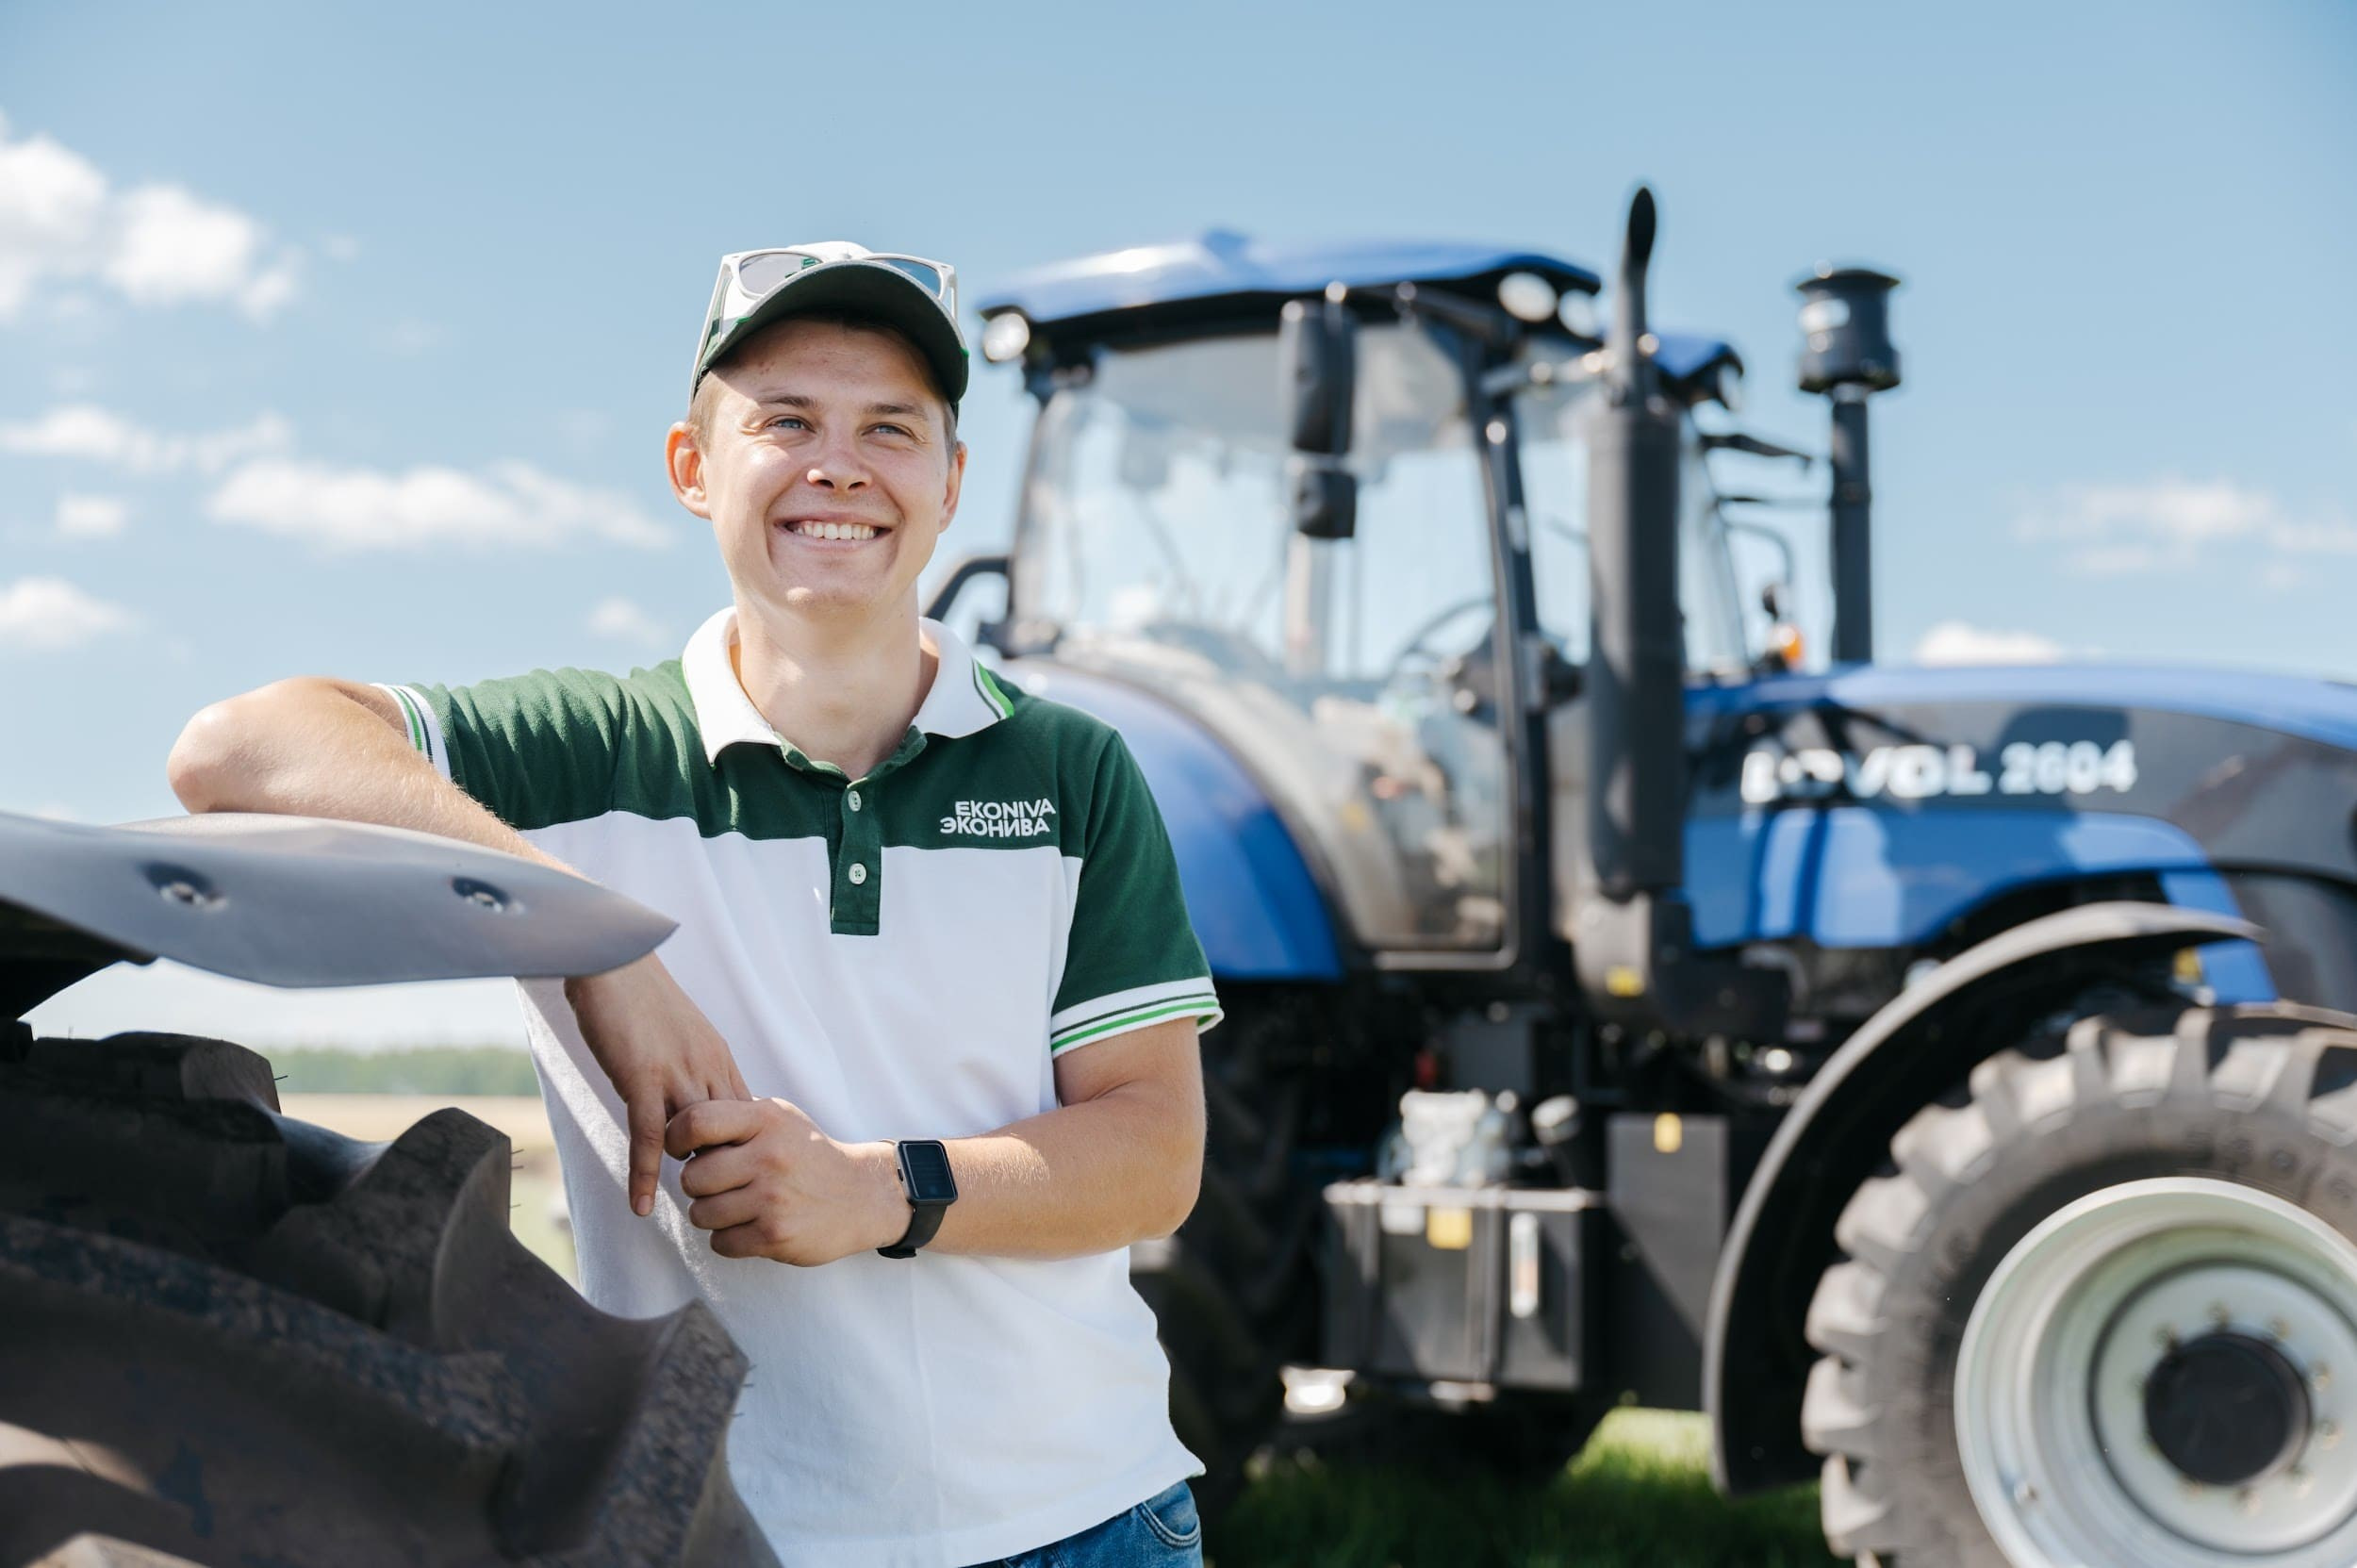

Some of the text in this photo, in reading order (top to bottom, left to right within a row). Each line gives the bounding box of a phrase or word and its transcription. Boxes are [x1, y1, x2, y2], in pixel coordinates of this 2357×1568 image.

[1999, 740, 2137, 795] 2604
[955, 798, 1056, 819] EKONIVA
[940, 817, 1050, 837] ЭКОНИВА
